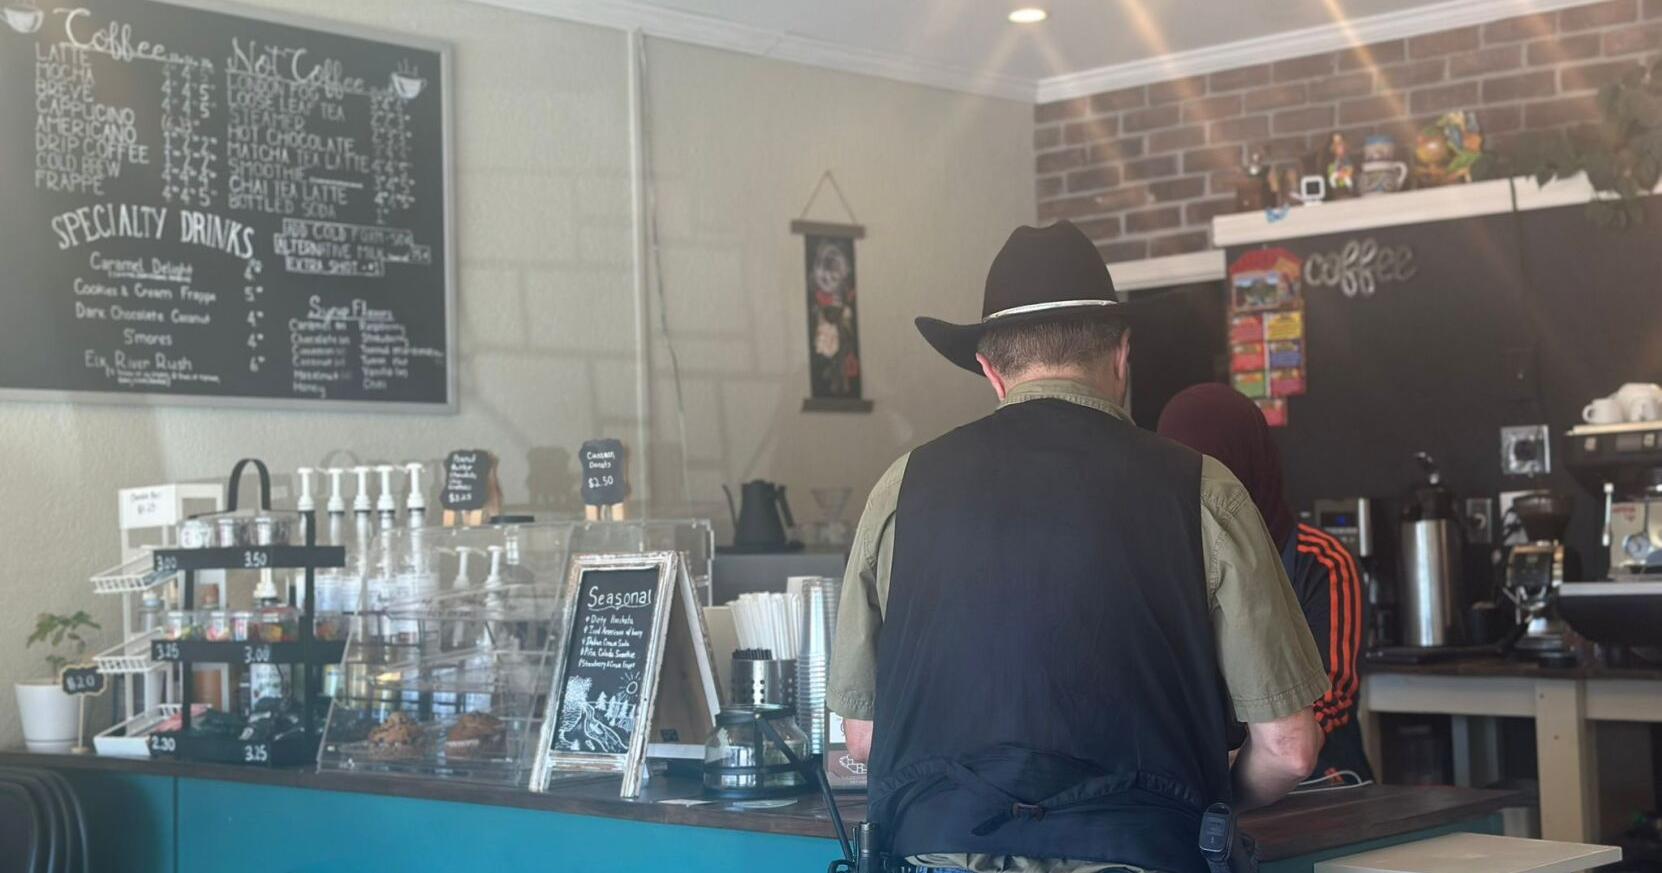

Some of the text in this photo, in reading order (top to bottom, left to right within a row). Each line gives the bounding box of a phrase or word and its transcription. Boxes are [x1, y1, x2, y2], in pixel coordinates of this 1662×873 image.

[53, 8, 166, 62] Coffee
[35, 42, 89, 67] LATTE
[35, 62, 94, 84] MOCHA
[35, 79, 94, 102] BREVE
[320, 102, 346, 121] TEA
[35, 114, 137, 145] AMERICANO
[227, 123, 355, 156] HOT CHOCOLATE
[35, 132, 150, 164] DRIP COFFEE
[227, 141, 291, 164] MATCHA
[295, 147, 321, 169] TEA
[35, 152, 78, 172] COLD
[35, 169, 104, 196] FRAPPE
[228, 174, 349, 205] CHAI TEA LATTE
[51, 202, 255, 260] SPECIALTY DRINKS
[1303, 237, 1418, 298] coffee
[73, 276, 119, 297] Cookies
[75, 301, 107, 320] Dark
[114, 349, 151, 370] River
[154, 351, 193, 372] Rush
[588, 474, 614, 489] $2.50
[244, 551, 268, 568] 3.50
[587, 585, 652, 608] Seasonal
[244, 645, 271, 664] 3.00
